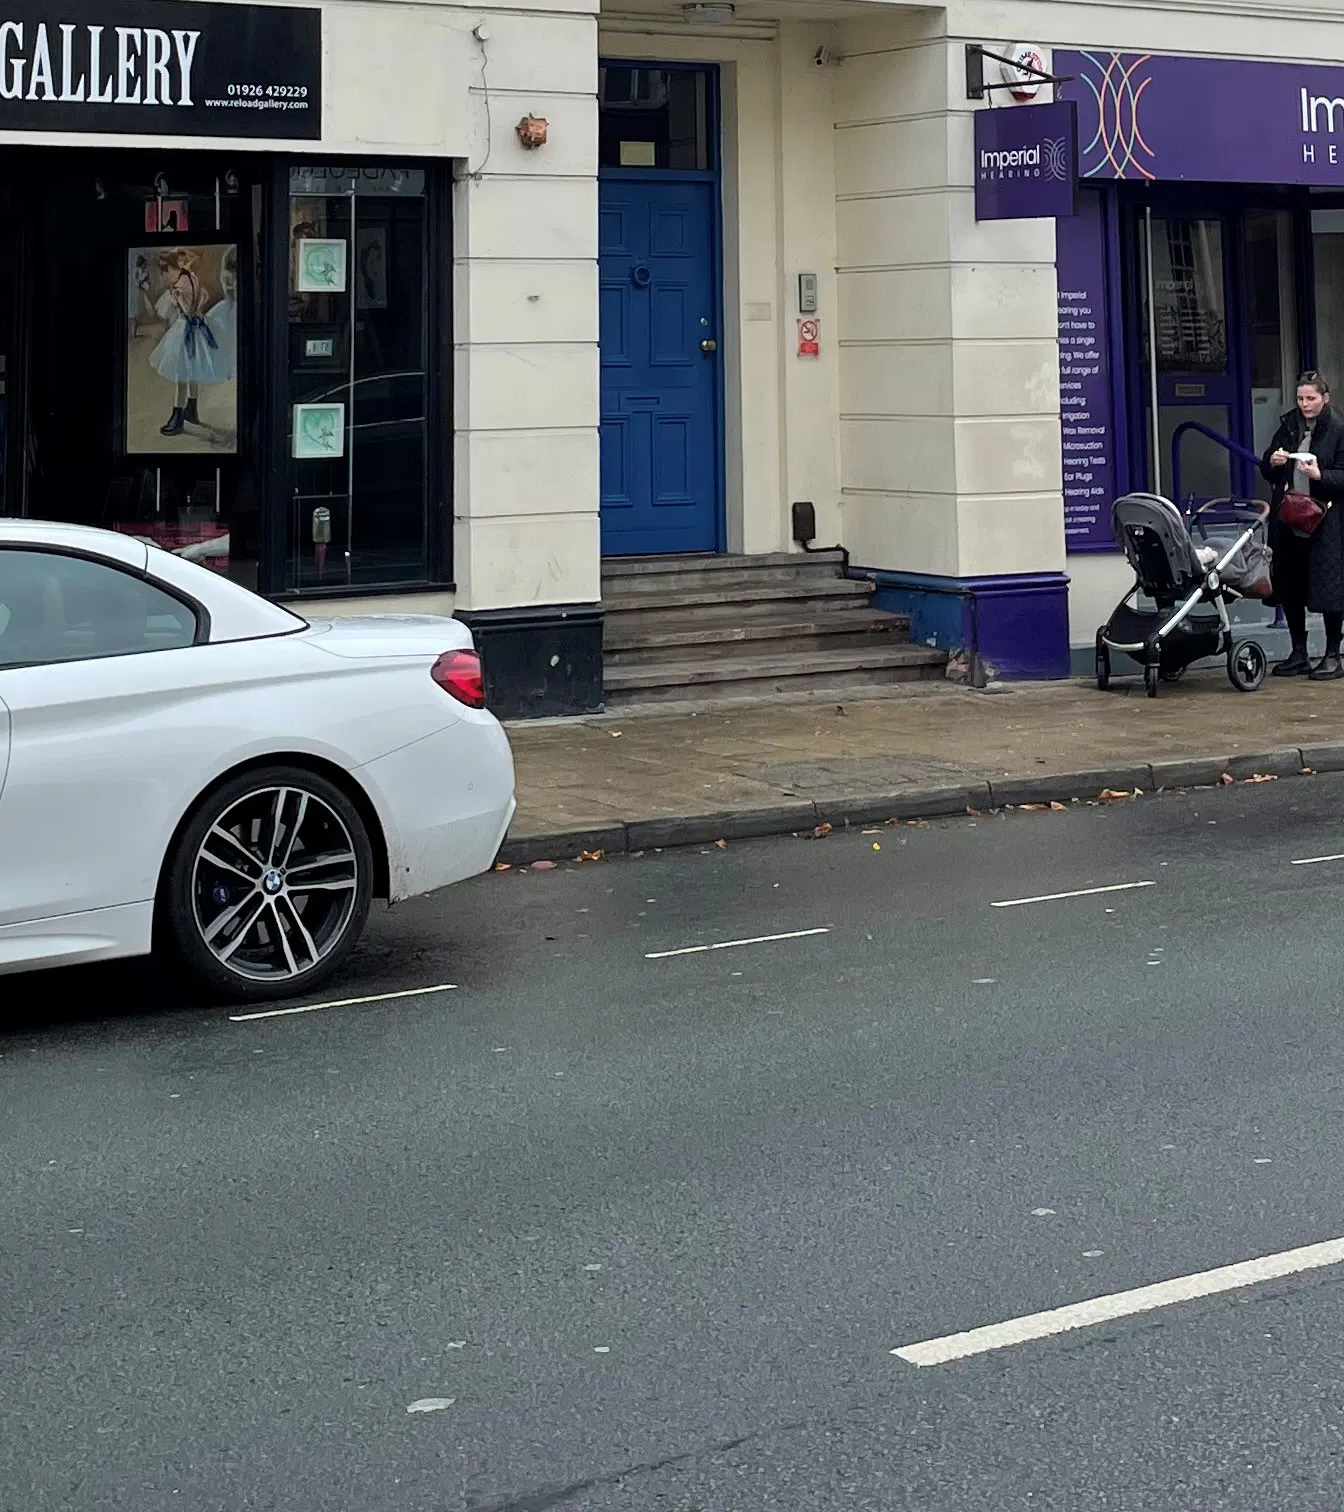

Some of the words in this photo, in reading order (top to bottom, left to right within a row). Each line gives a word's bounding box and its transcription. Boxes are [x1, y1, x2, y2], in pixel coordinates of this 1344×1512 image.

[227, 84, 263, 96] 01926
[265, 85, 308, 97] 429229
[205, 98, 309, 110] www.reloadgallery.com
[981, 145, 1040, 170] Imperial
[981, 168, 1041, 180] HEARING
[1058, 307, 1078, 316] earing
[1064, 457, 1088, 467] Hearing
[1089, 456, 1106, 465] Tests
[1065, 488, 1090, 497] Hearing
